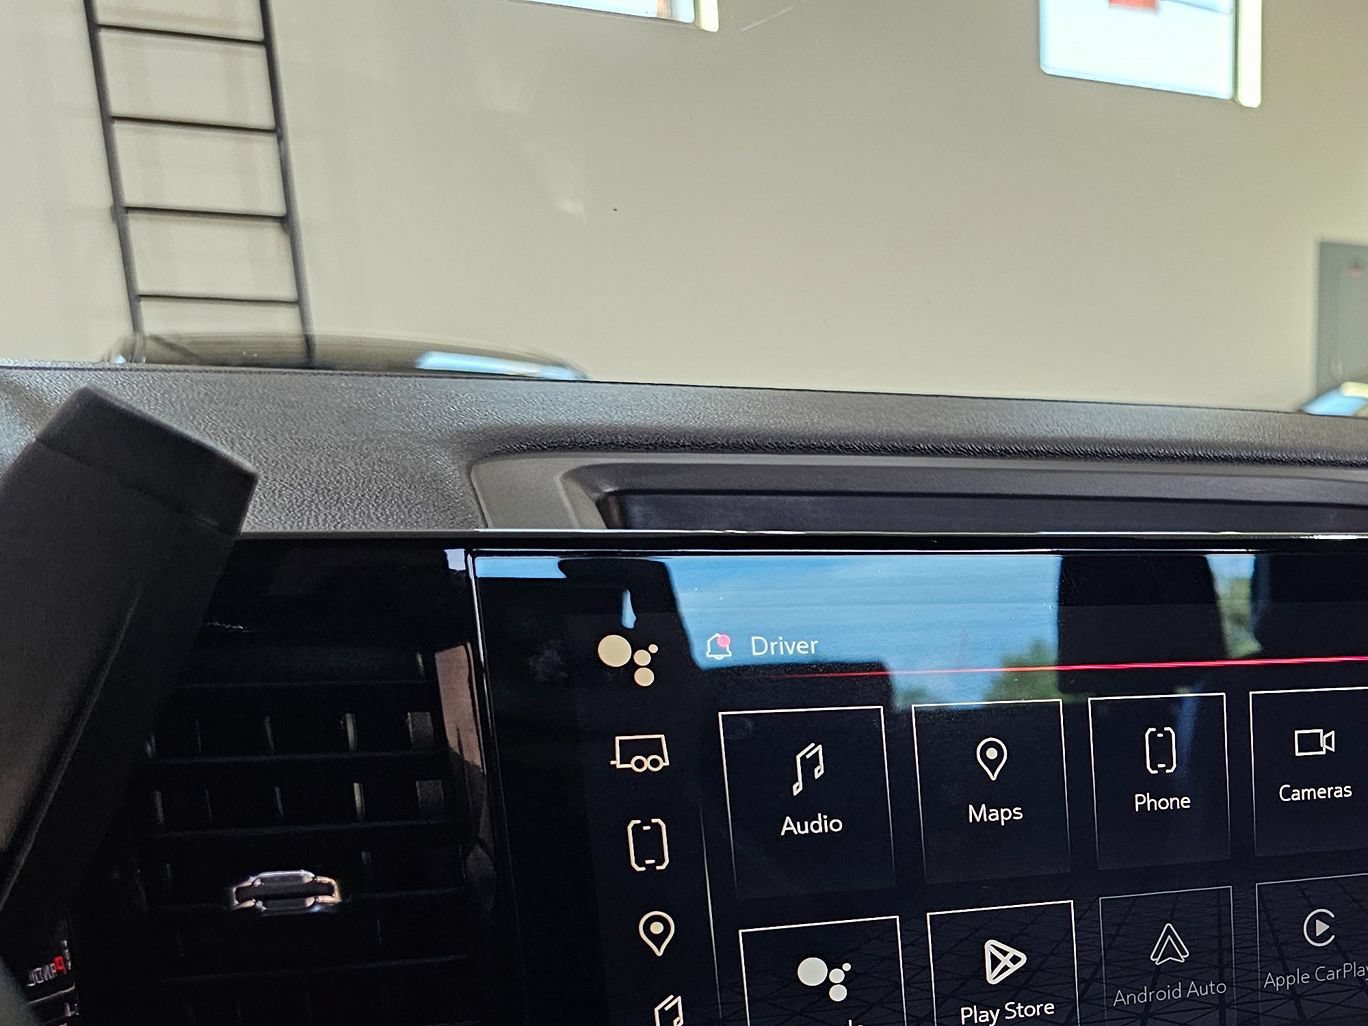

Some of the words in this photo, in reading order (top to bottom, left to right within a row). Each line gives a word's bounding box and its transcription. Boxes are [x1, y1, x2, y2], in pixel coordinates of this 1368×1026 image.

[750, 634, 819, 656] Driver
[1134, 792, 1191, 812] Phone
[1278, 784, 1353, 802] Cameras
[780, 812, 843, 836] Audio
[968, 803, 1024, 827] Maps
[1263, 967, 1310, 992] Apple
[1113, 981, 1182, 1007] Android
[1186, 980, 1227, 998] Auto
[1004, 1001, 1055, 1020] Store
